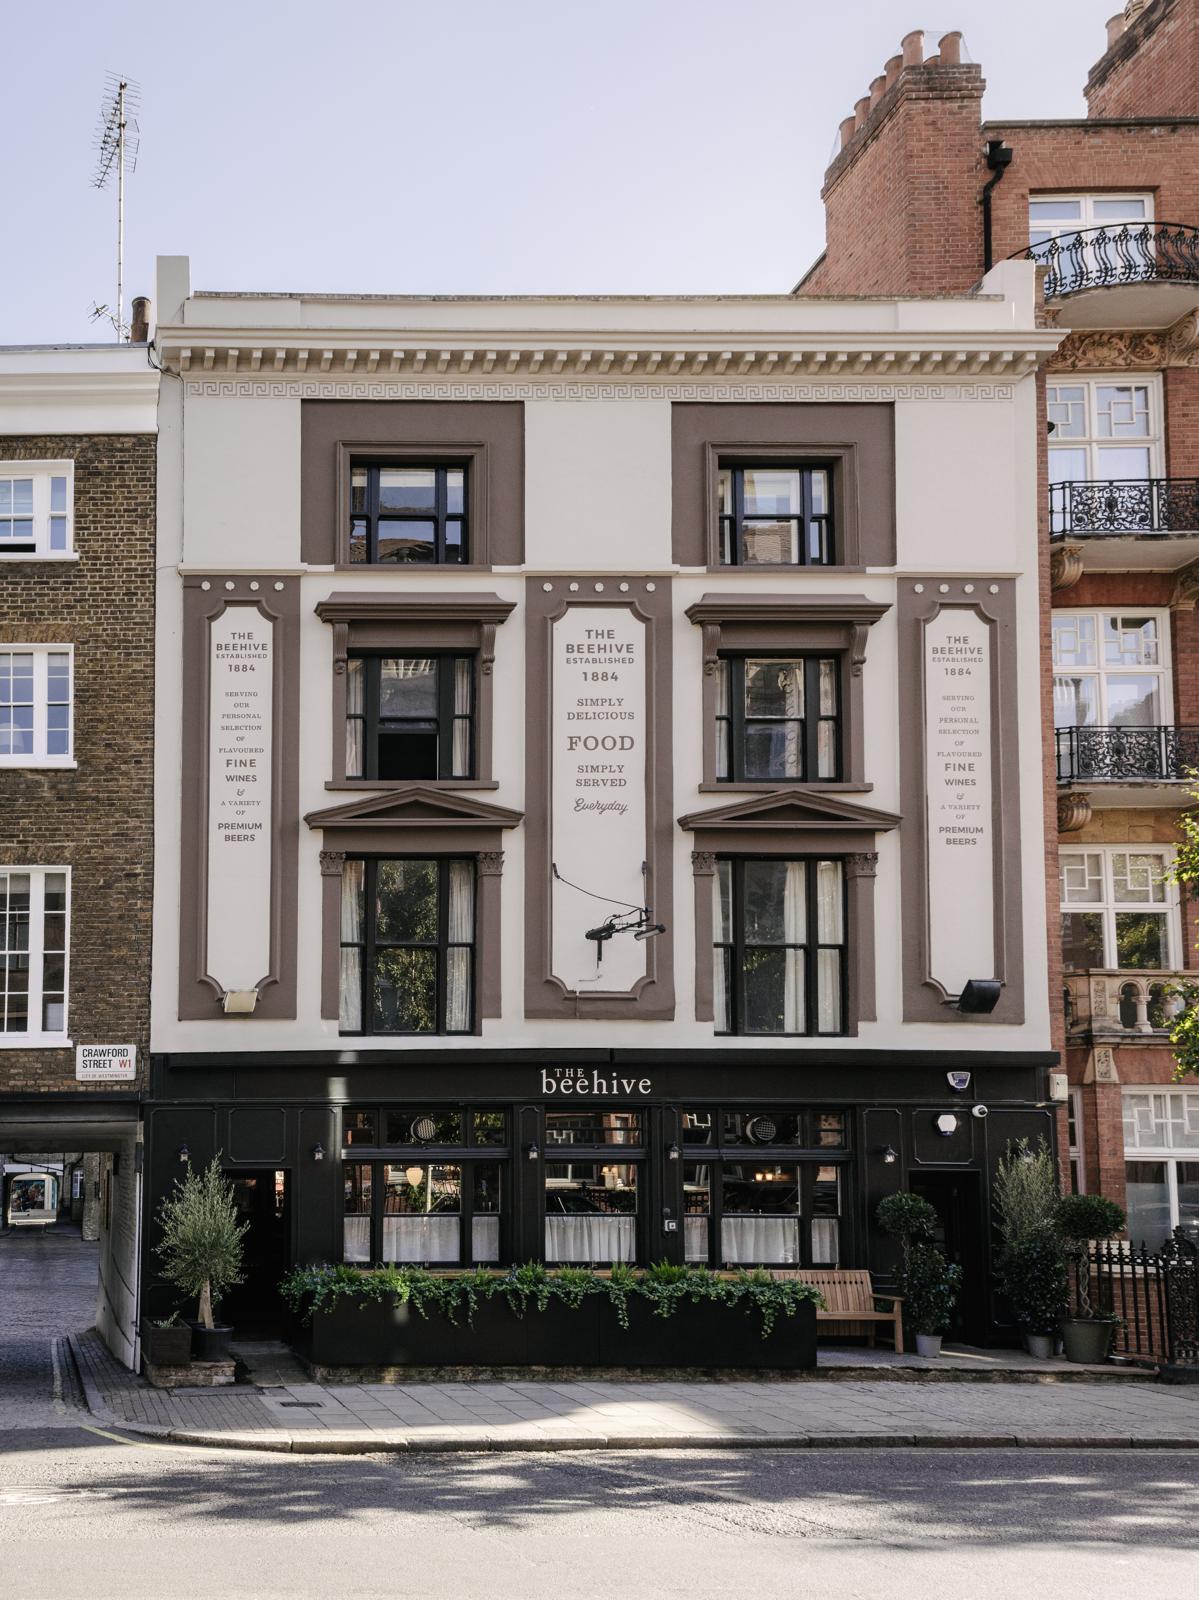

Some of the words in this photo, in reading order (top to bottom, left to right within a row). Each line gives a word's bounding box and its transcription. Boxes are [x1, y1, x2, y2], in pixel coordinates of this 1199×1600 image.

[231, 632, 254, 640] THE
[585, 629, 615, 639] THE
[946, 636, 969, 644] THE
[216, 643, 268, 651] BEEHIVE
[566, 644, 634, 653] BEEHIVE
[228, 664, 256, 672] 1884
[944, 668, 971, 676] 1884
[582, 672, 618, 681] 1884
[577, 698, 624, 706] SIMPLY
[567, 712, 634, 720] DELICIOUS
[567, 736, 634, 750] FOOD
[226, 759, 256, 767] FINE
[945, 763, 975, 771] FINE
[577, 765, 624, 773] SIMPLY
[576, 778, 626, 787] SERVED
[236, 788, 245, 796] &
[574, 798, 628, 815] Everyday
[225, 834, 255, 842] BEERS
[82, 1048, 128, 1058] CRAWFORD
[82, 1060, 112, 1068] STREET
[119, 1059, 131, 1068] W1
[555, 1069, 585, 1077] THE
[541, 1069, 652, 1094] beehive
